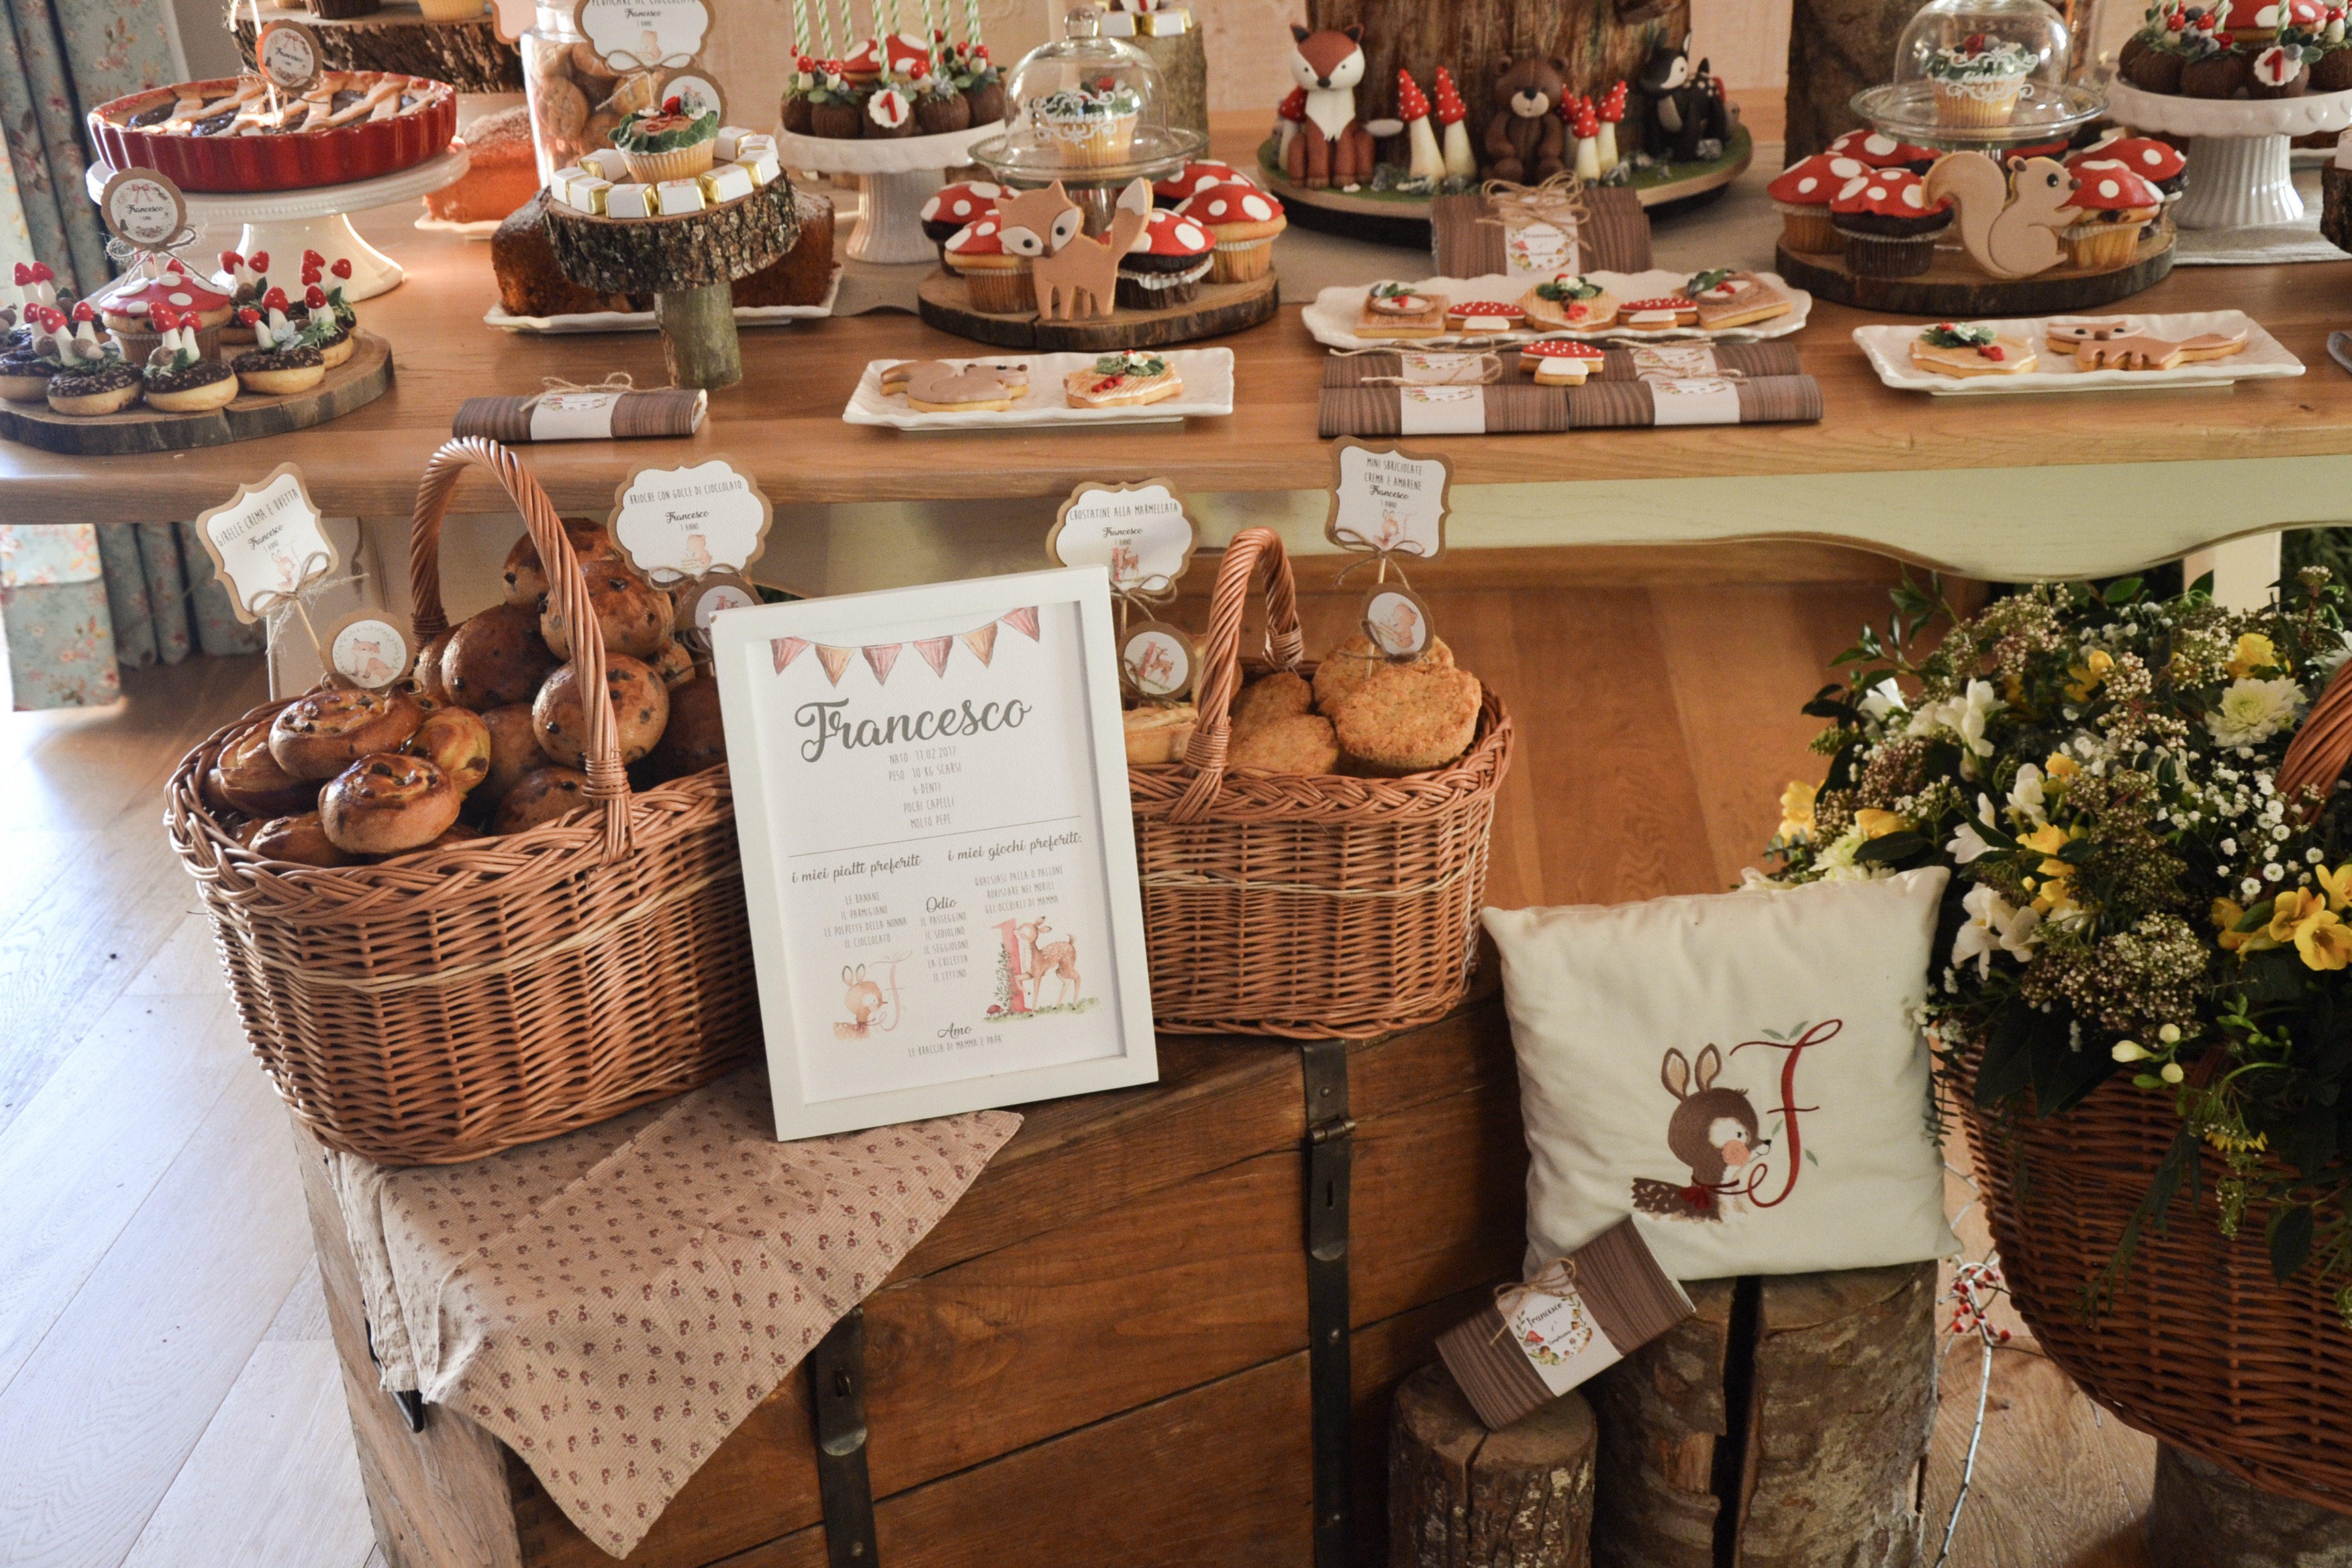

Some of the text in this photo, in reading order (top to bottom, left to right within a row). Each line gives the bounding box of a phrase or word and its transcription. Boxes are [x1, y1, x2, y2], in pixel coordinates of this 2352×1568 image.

[624, 7, 662, 18] Francesco
[124, 203, 165, 214] Francesco
[1367, 457, 1422, 475] MINI SBRICIOLATE
[1364, 472, 1421, 491] CREMA E AMARENE
[629, 480, 742, 504] BRIOCHE CON GOCCE DI CIOCCOLATO
[1369, 484, 1409, 500] Francesco
[1069, 503, 1179, 521] CROSTATINE ALLA MARMELLATA
[1384, 500, 1396, 508] ANNO
[216, 488, 299, 546] GIRELLE CREMA E UVETTA
[665, 510, 708, 523] Francesco
[685, 522, 698, 531] ANNO
[1102, 527, 1142, 538] Francesco
[247, 525, 283, 550] Francesco
[794, 697, 1032, 762] Francesco
[915, 745, 956, 761] 11.02.2017
[911, 767, 921, 778] 10
[923, 766, 933, 777] KG
[936, 762, 961, 774] SCARSI
[912, 781, 941, 794] 6 DENTI
[903, 796, 953, 813] POCHI CAPELLI
[909, 813, 951, 829] MOLTO PEPE
[947, 850, 954, 861] i
[957, 845, 984, 860] miei
[987, 839, 1026, 861] giochi
[791, 872, 798, 883] i
[802, 867, 829, 882] miei
[833, 861, 866, 883] piatti
[974, 865, 1063, 886] QUALSIASI PALLA O PALLONE
[845, 891, 879, 905] LE BANANE
[986, 881, 1054, 898] ROVISTARE NEI MOBILI
[840, 904, 887, 920] IL PARMIGIANO
[926, 896, 958, 913] Odio
[985, 894, 1059, 914] GLI OCCHIALI DI MAMMA
[823, 916, 907, 937] LE POLPETTE DELLA NONNA
[920, 911, 966, 926] IL PASSEGGINO
[844, 933, 891, 949] IL CIOCCOLATO
[925, 926, 965, 940] IL SEDIOLINO
[924, 938, 968, 955] IL SEGGIOLONE
[927, 954, 968, 968] LA CULLETTA
[932, 968, 966, 982] IL LETTINO
[936, 1022, 972, 1039] Amo
[908, 1047, 915, 1057] LE
[917, 1043, 944, 1056] BRACCIA
[946, 1042, 953, 1051] DI
[955, 1038, 977, 1049] MAMMA
[979, 1036, 983, 1046] E
[1526, 1302, 1563, 1328] Francesco
